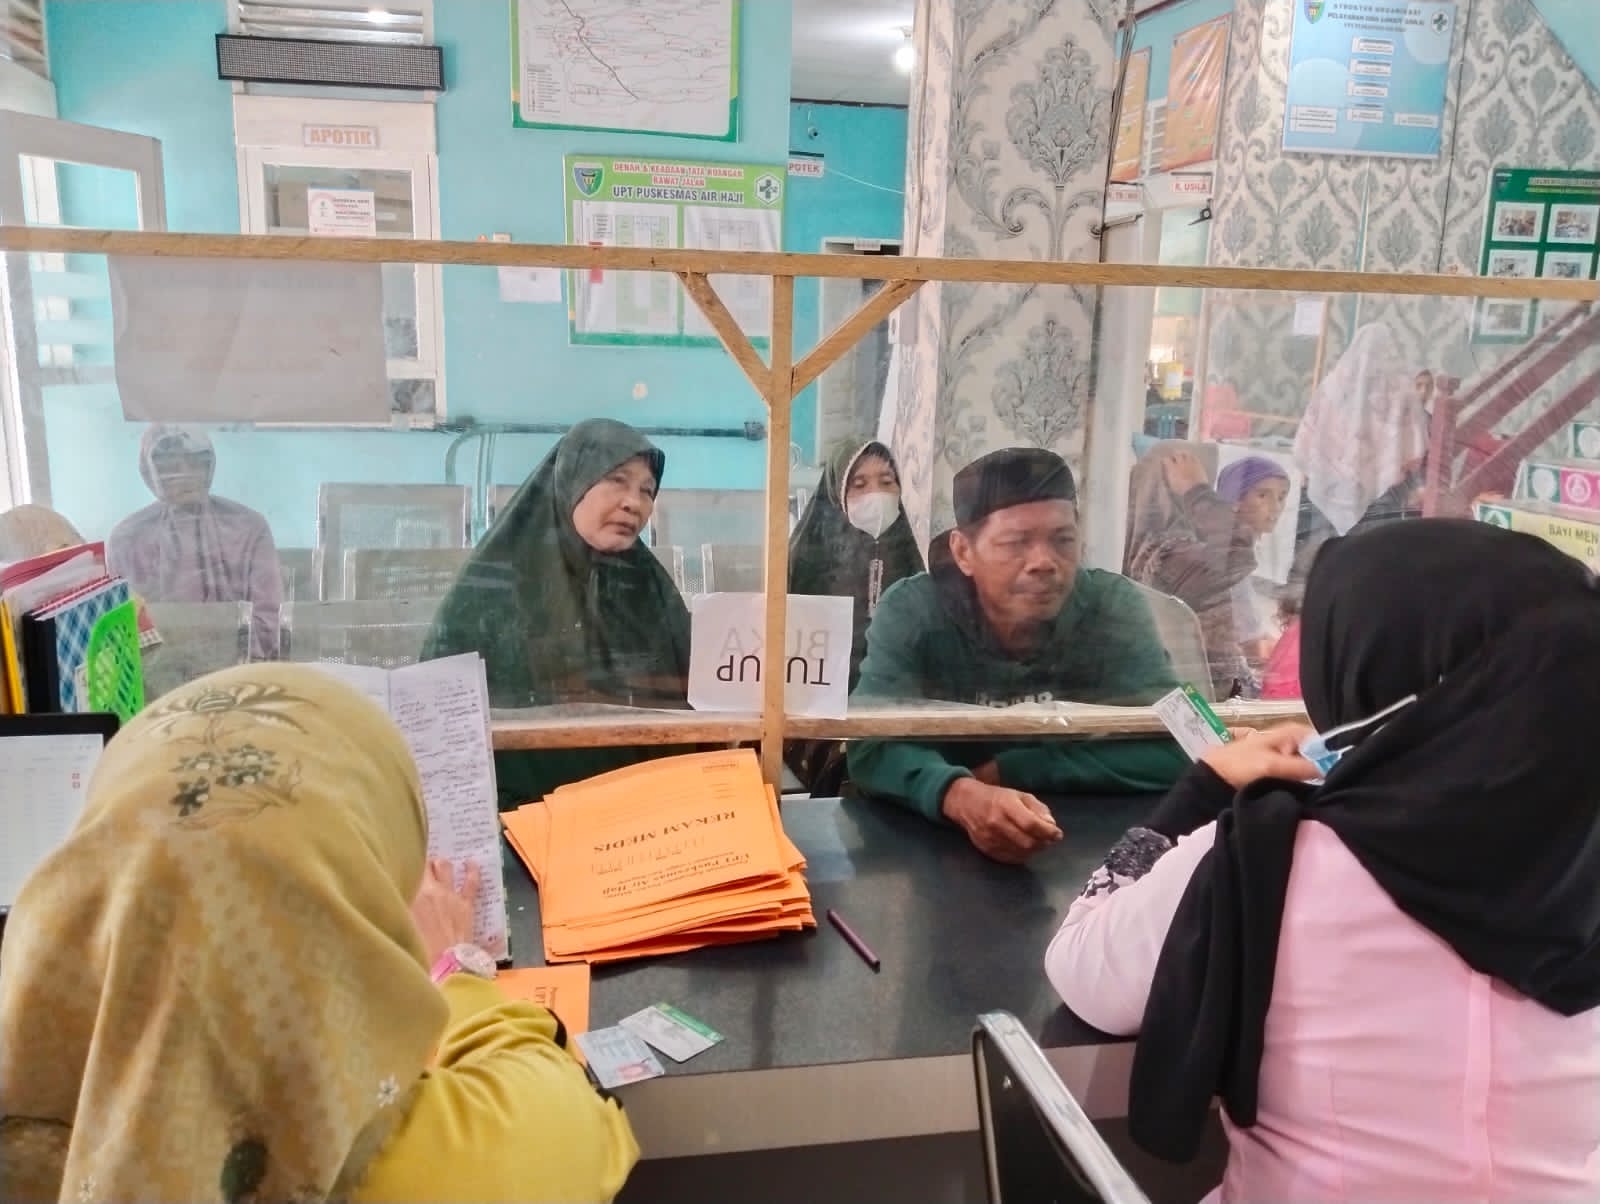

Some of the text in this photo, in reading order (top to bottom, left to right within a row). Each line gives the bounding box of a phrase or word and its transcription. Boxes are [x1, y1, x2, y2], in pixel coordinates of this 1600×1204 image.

[310, 128, 372, 145] APOTIK
[614, 161, 641, 172] DENAH
[651, 164, 686, 174] KEADAAN
[688, 166, 705, 176] TATA
[653, 175, 705, 187] RAWAT JALAN
[613, 186, 744, 203] UPT PUSKESMAS AIR HAJI
[1549, 524, 1572, 538] BAYI
[716, 655, 831, 686] TUUP
[593, 811, 735, 852] REKAM MEDIS
